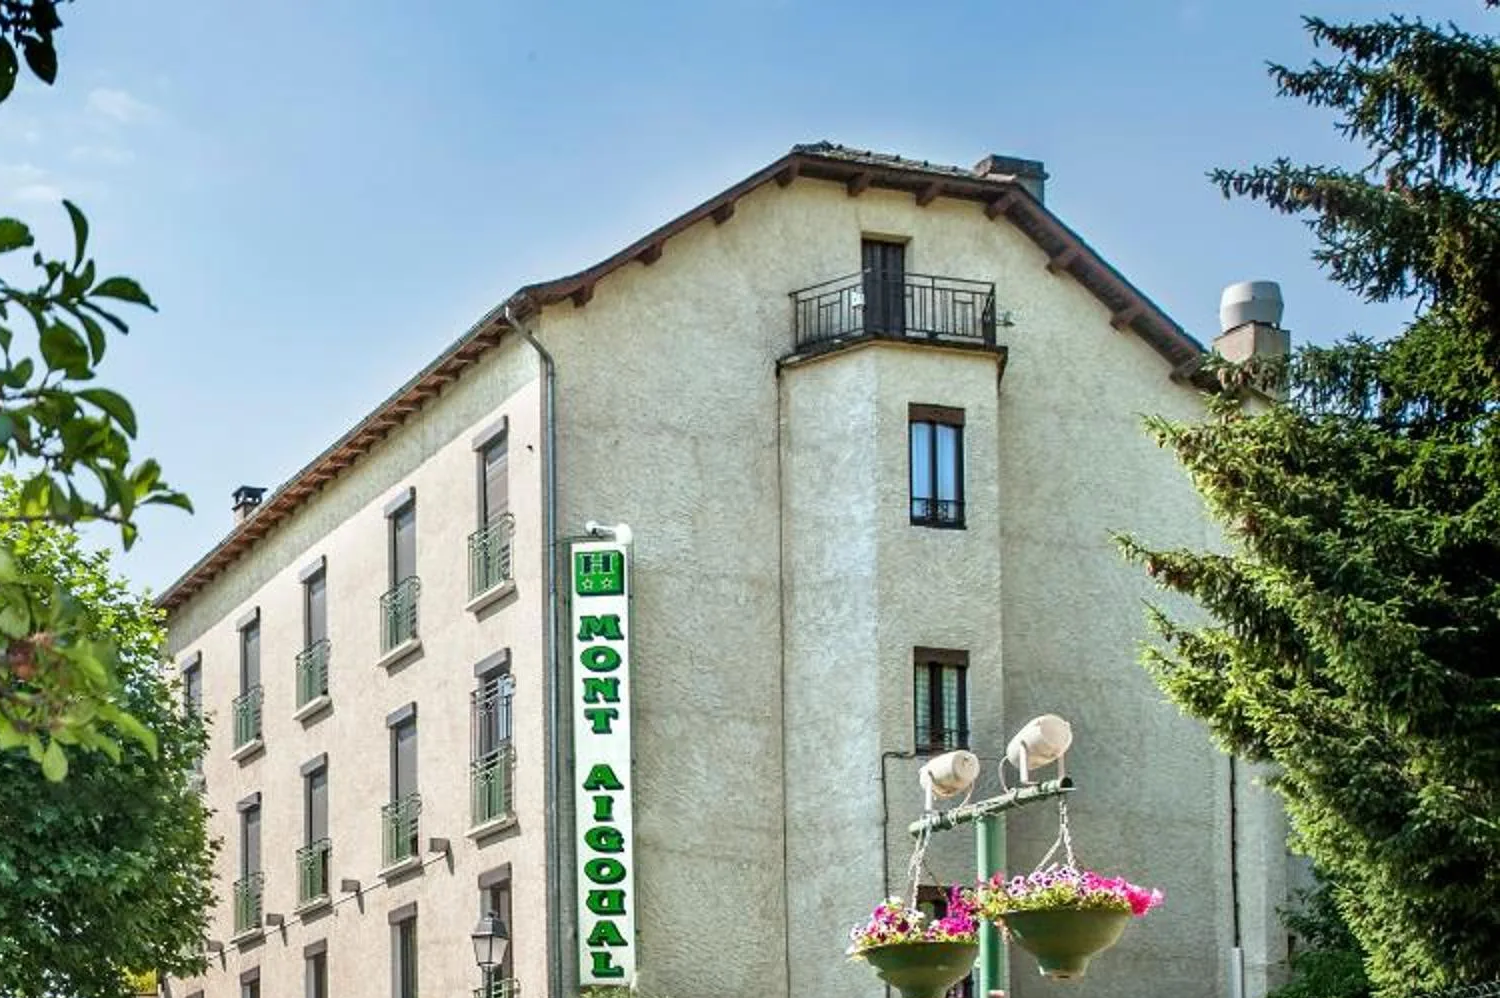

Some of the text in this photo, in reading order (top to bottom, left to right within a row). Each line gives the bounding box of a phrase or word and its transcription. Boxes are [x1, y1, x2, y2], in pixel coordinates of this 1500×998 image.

[580, 553, 614, 575] H
[577, 614, 628, 978] MONT AIGOUAL
